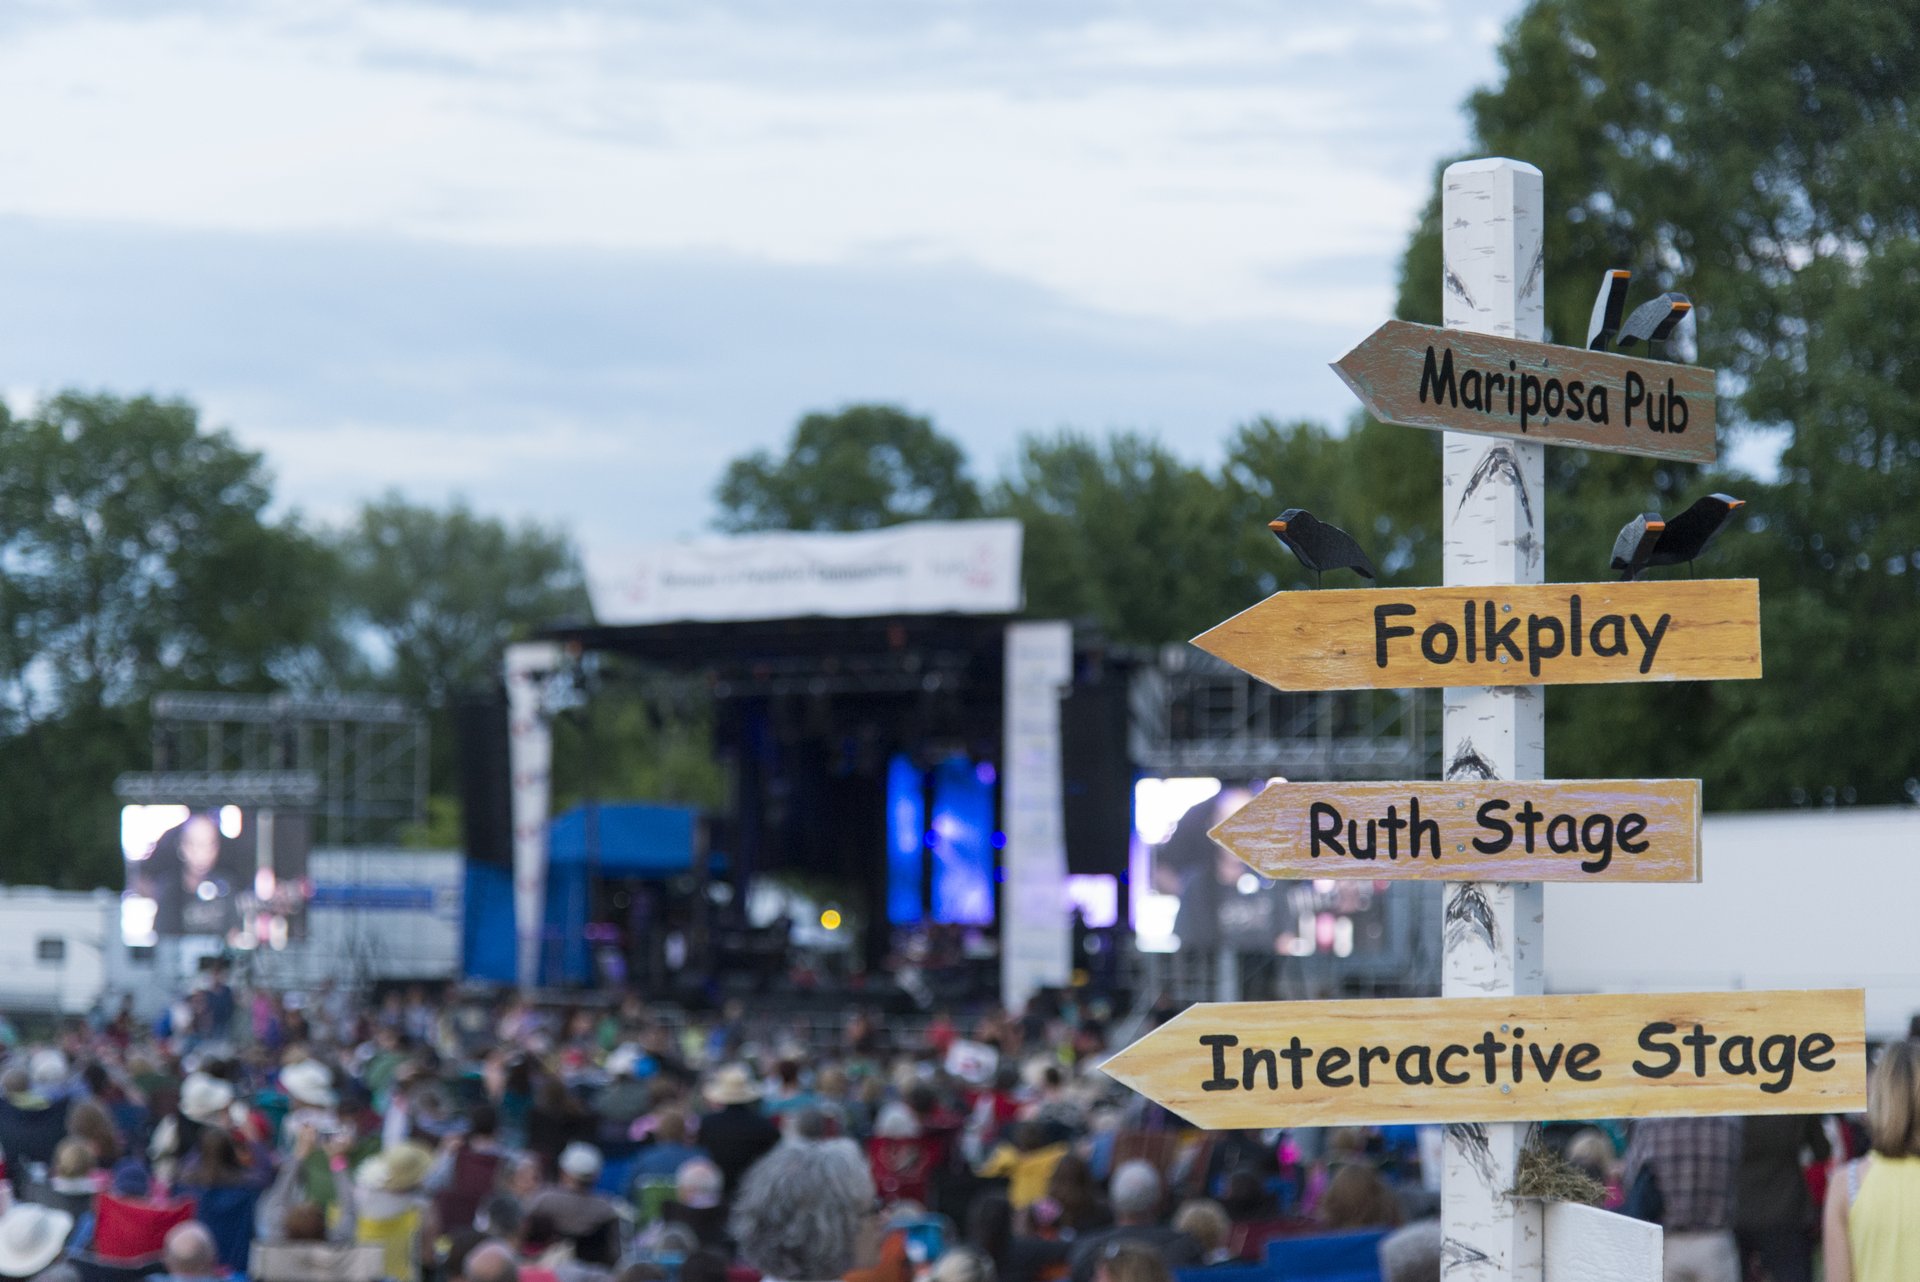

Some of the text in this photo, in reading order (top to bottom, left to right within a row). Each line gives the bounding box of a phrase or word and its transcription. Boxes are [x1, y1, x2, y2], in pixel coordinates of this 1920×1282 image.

[1419, 345, 1689, 434] Mariposa Pub
[1374, 594, 1671, 677] Folkplay
[1309, 796, 1649, 873] Ruth Stage
[1200, 1021, 1836, 1095] Interactive Stage
